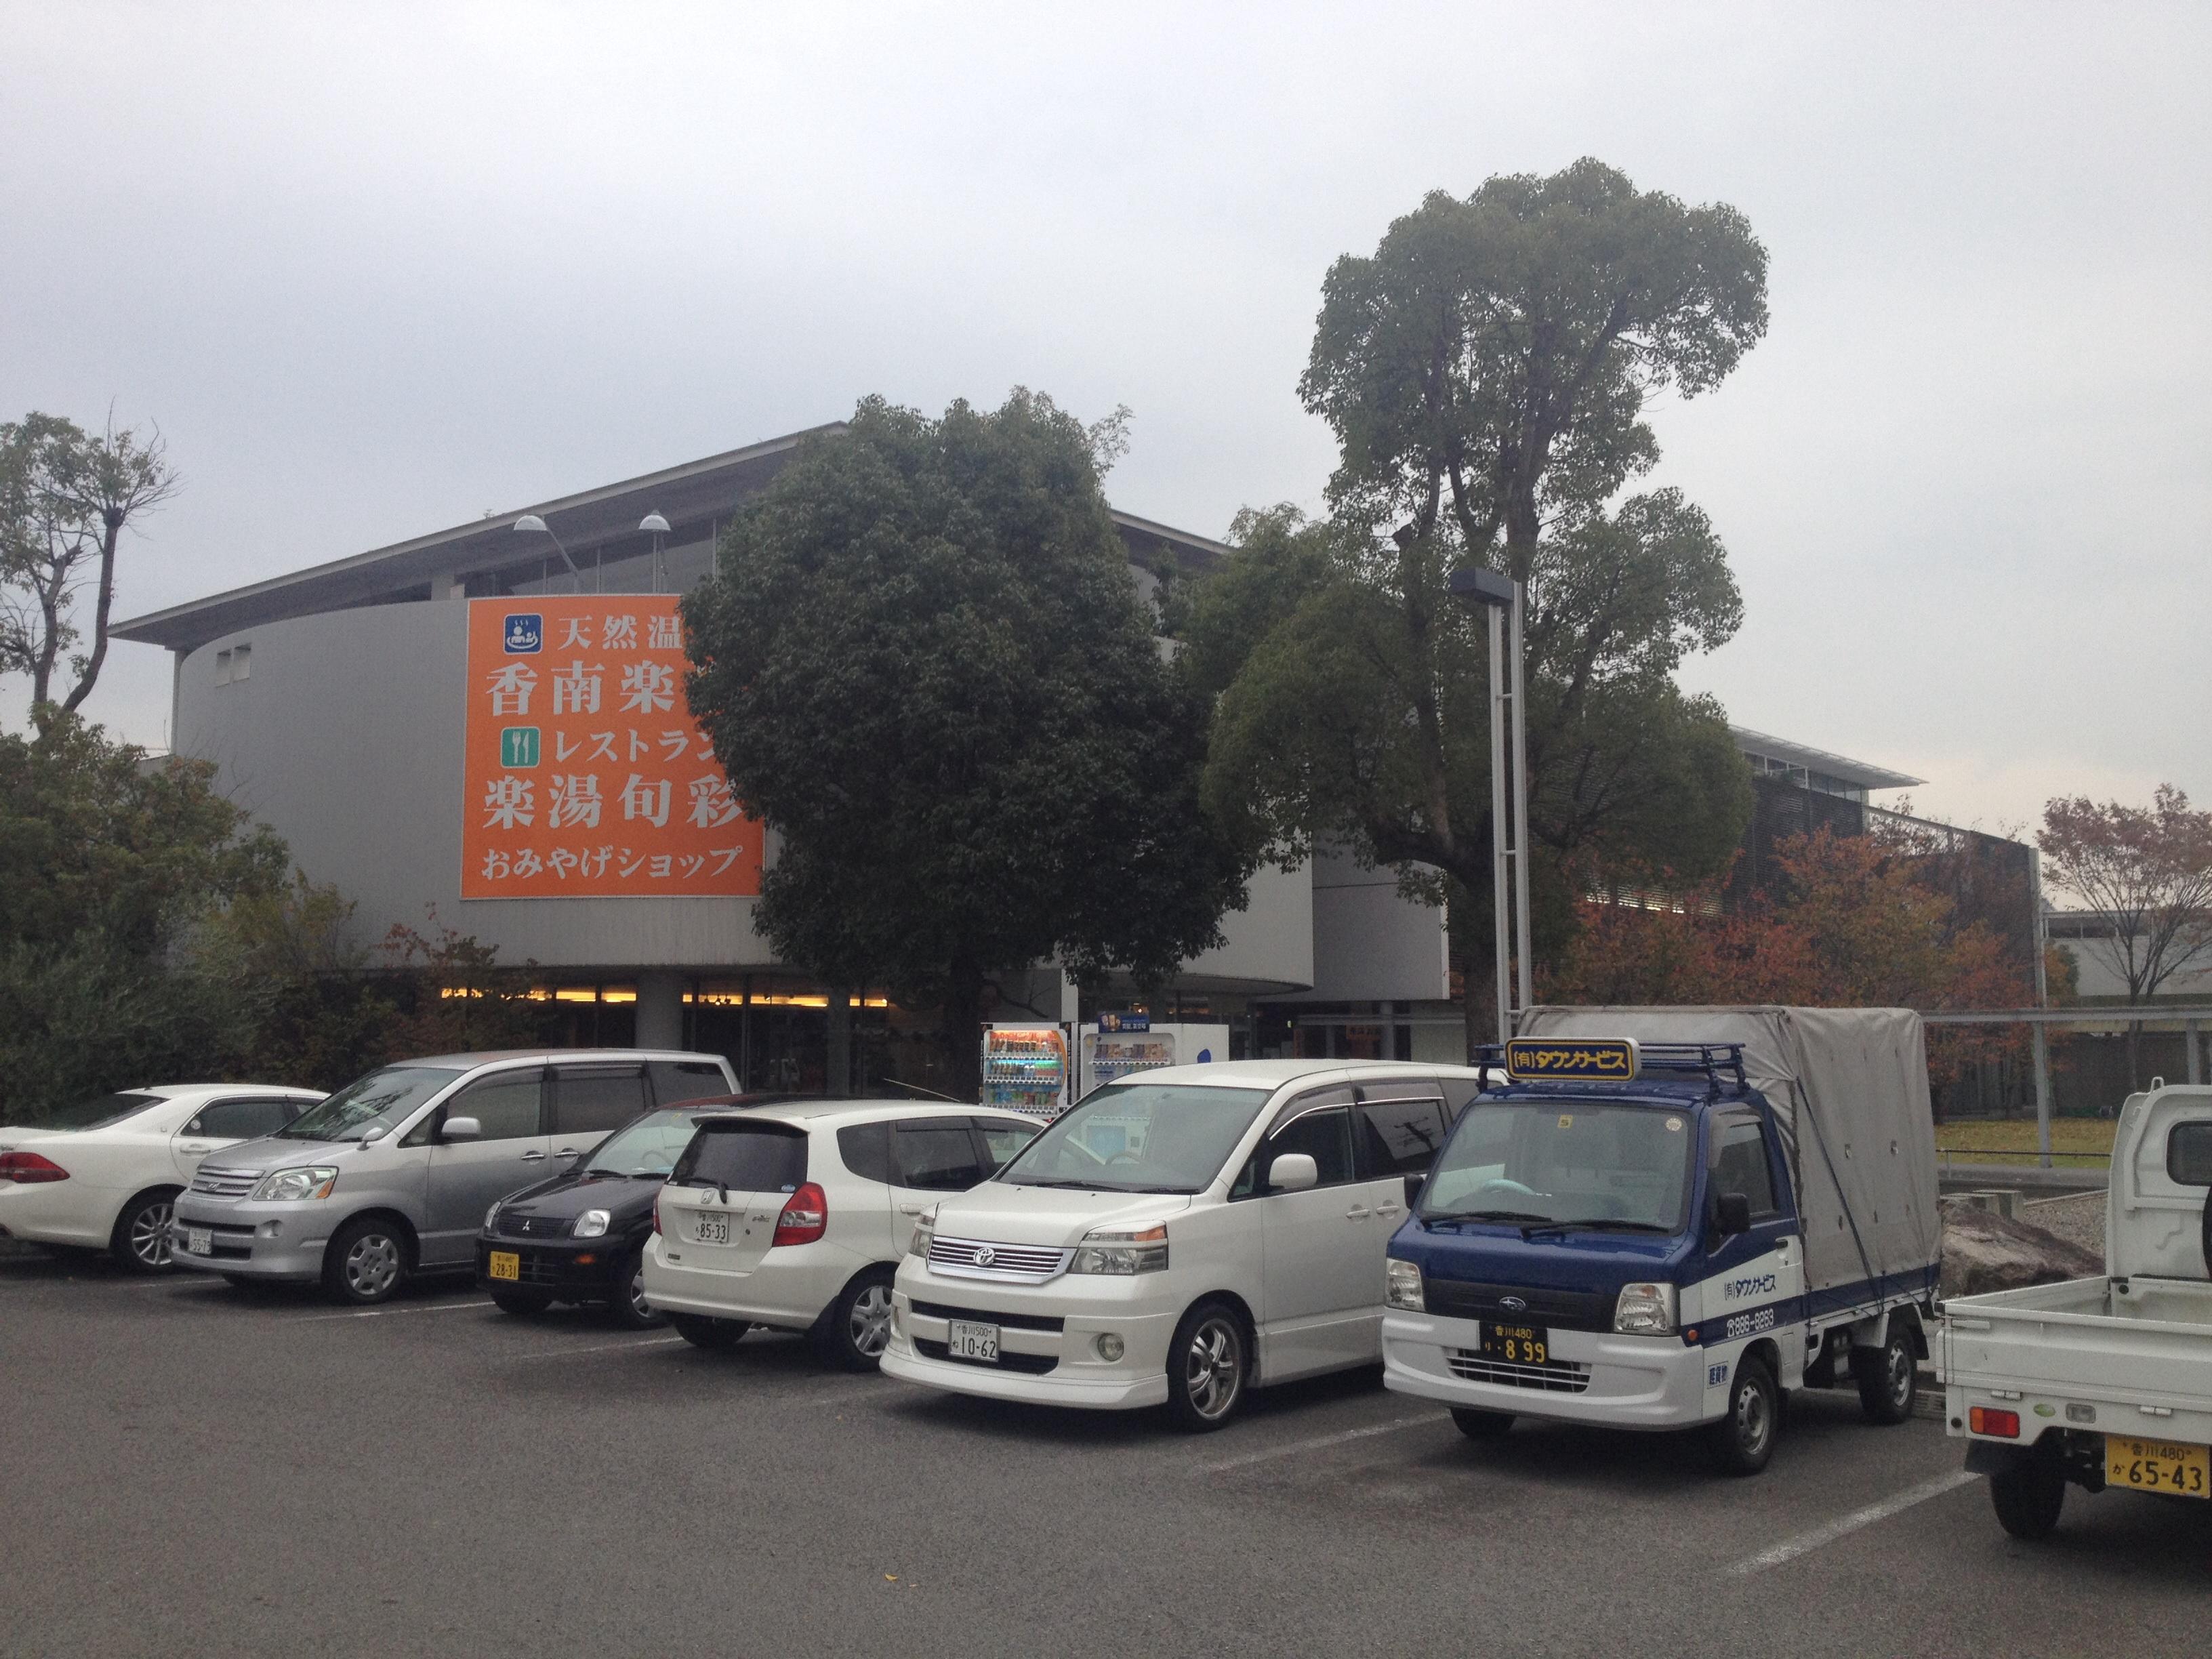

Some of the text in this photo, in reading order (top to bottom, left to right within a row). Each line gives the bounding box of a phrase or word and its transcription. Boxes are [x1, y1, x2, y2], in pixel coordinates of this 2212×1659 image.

[485, 659, 716, 716] 香南楽
[483, 773, 743, 830] 楽湯旬彩
[482, 845, 743, 879] おみやげショップ
[700, 1223, 726, 1240] 85-33
[496, 1263, 516, 1278] 28-31
[1495, 1326, 1533, 1339] 香川480
[962, 1336, 996, 1358] 10-62
[2131, 1443, 2185, 1461] 香川480
[2129, 1460, 2202, 1491] 65-43
